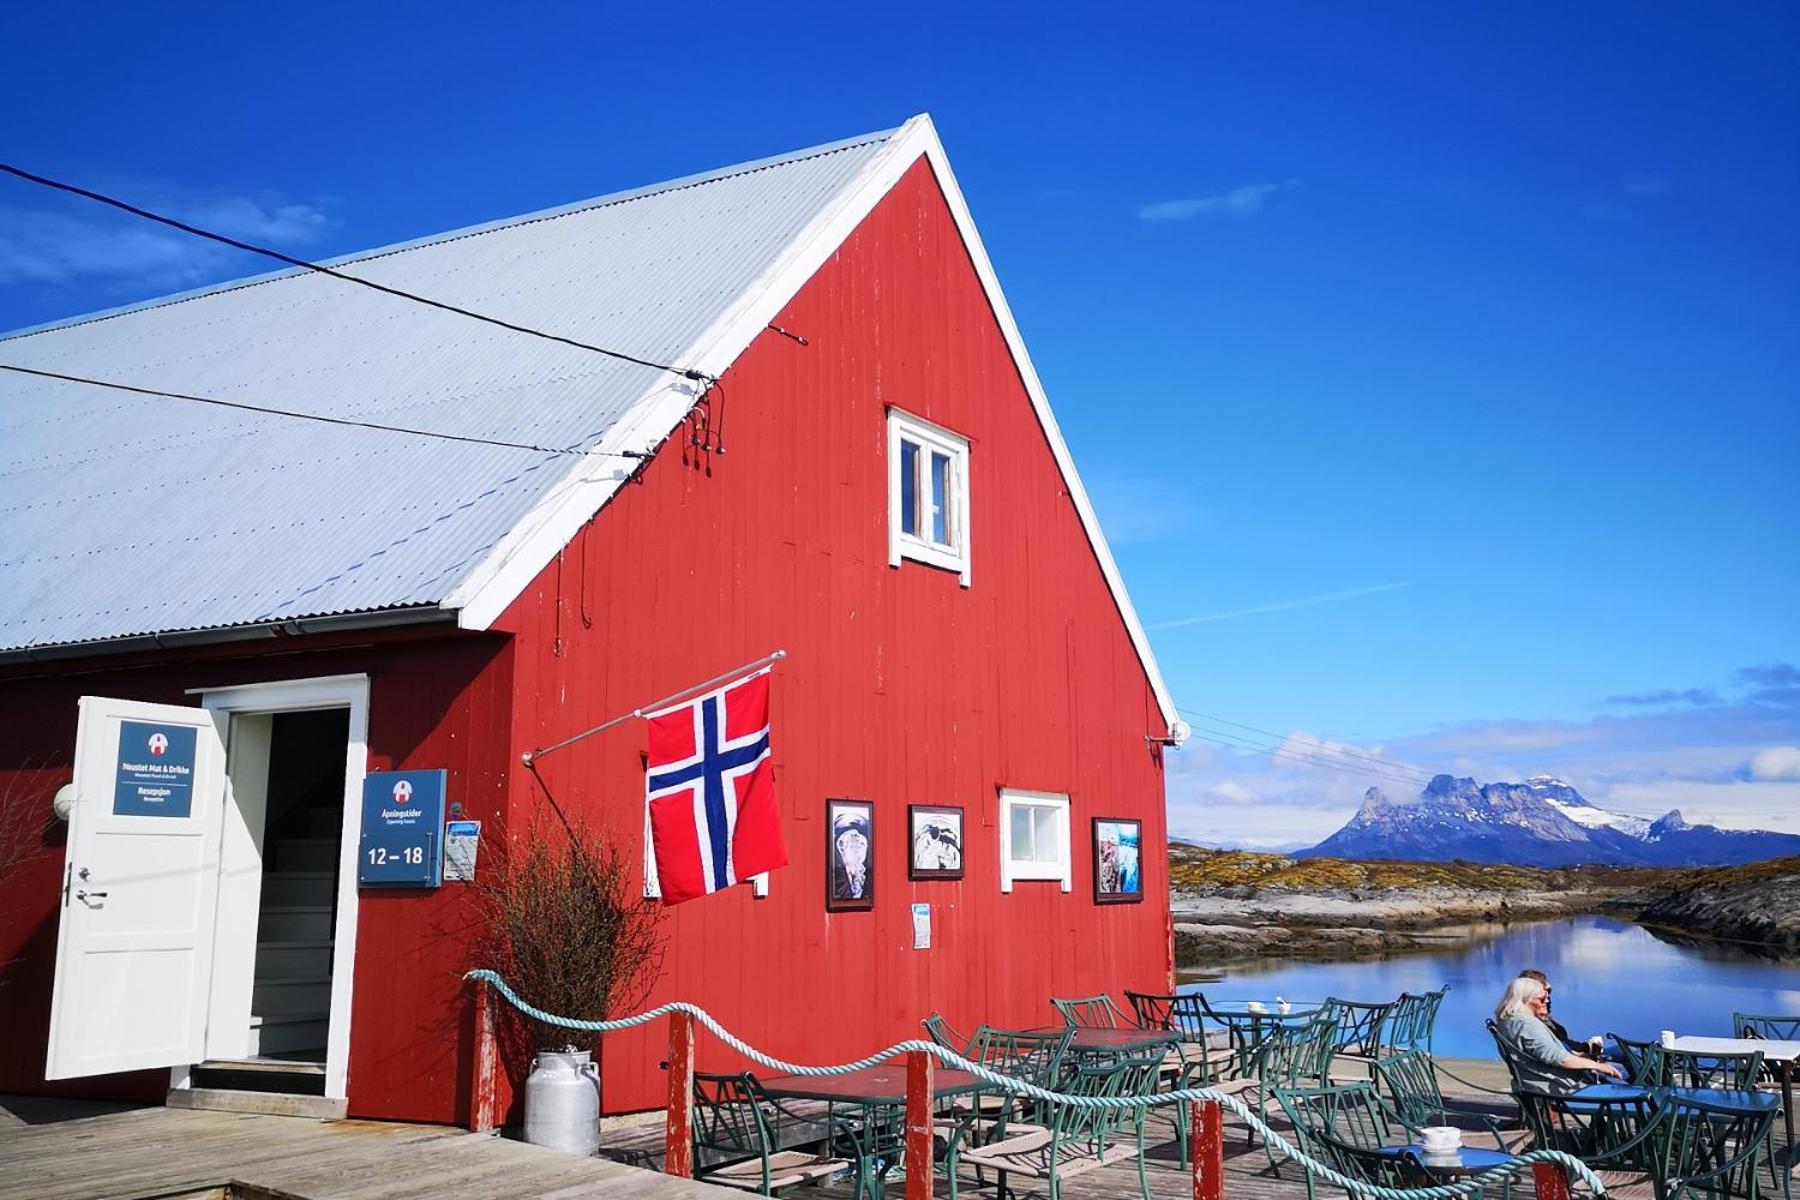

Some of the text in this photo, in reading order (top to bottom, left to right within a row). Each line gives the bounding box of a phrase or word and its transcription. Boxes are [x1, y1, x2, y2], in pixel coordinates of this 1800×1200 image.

[122, 763, 190, 774] Naustet Mat & Drikke
[138, 787, 171, 796] Resepsjon
[368, 848, 386, 864] 12
[403, 847, 423, 864] 18
